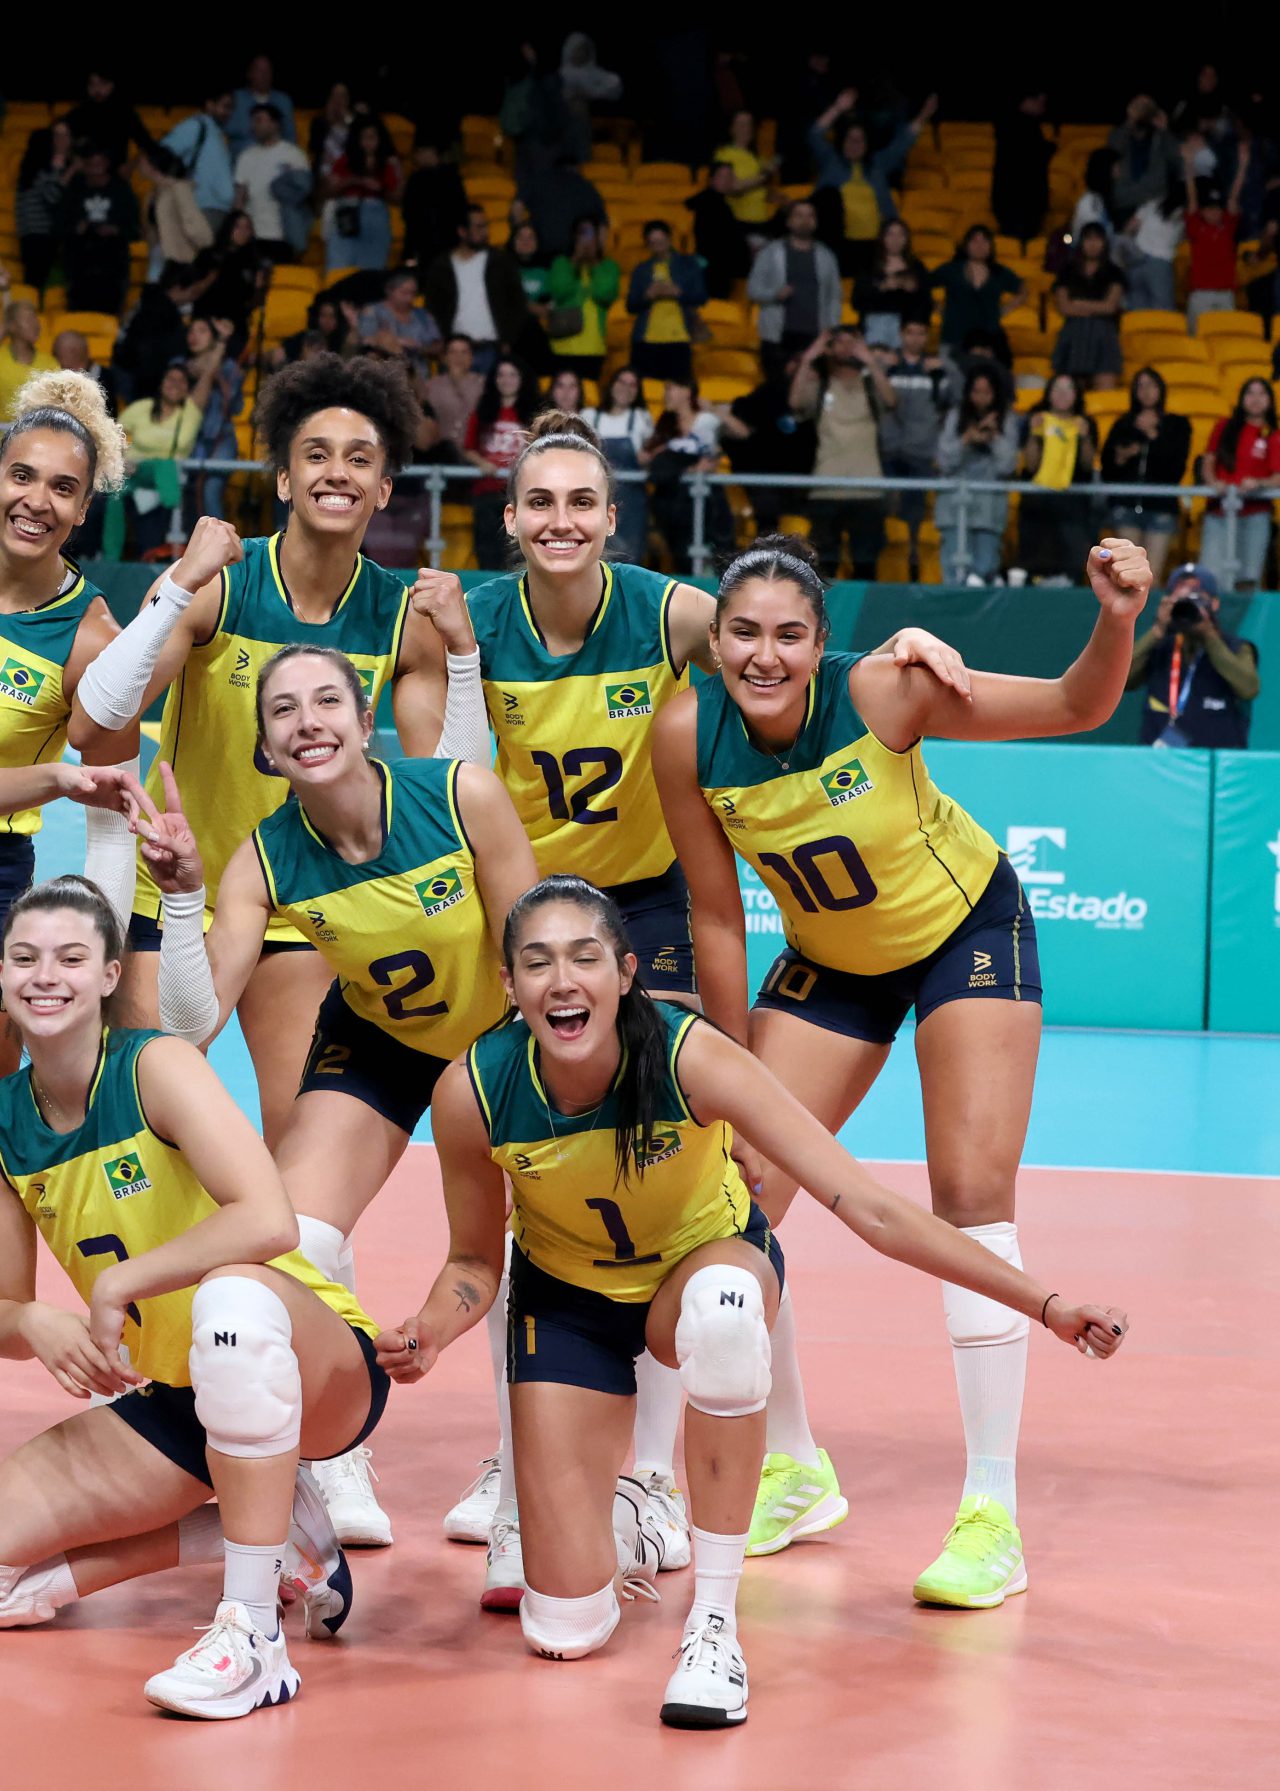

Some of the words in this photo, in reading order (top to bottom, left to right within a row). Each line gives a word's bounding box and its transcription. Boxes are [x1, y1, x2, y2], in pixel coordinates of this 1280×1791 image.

[228, 679, 251, 689] WORK
[230, 672, 251, 681] BODY
[609, 706, 652, 719] BRASIL
[531, 746, 623, 825] 12
[831, 782, 874, 807] BRASIL
[757, 835, 878, 913] 10
[425, 890, 466, 917] BRASIL
[743, 889, 779, 910] TO
[1029, 887, 1148, 922] Estado
[651, 963, 679, 973] WORK
[654, 957, 678, 967] BODY
[368, 949, 449, 1021] 2
[764, 958, 818, 1001] 10
[970, 973, 996, 982] BODY
[314, 1043, 352, 1075] 2
[638, 1145, 683, 1168] BRASIL
[114, 1181, 152, 1200] BRASIL
[585, 1197, 662, 1266] 1
[720, 1290, 744, 1308] N1
[214, 1331, 237, 1347] N1
[524, 1315, 536, 1355] 1
